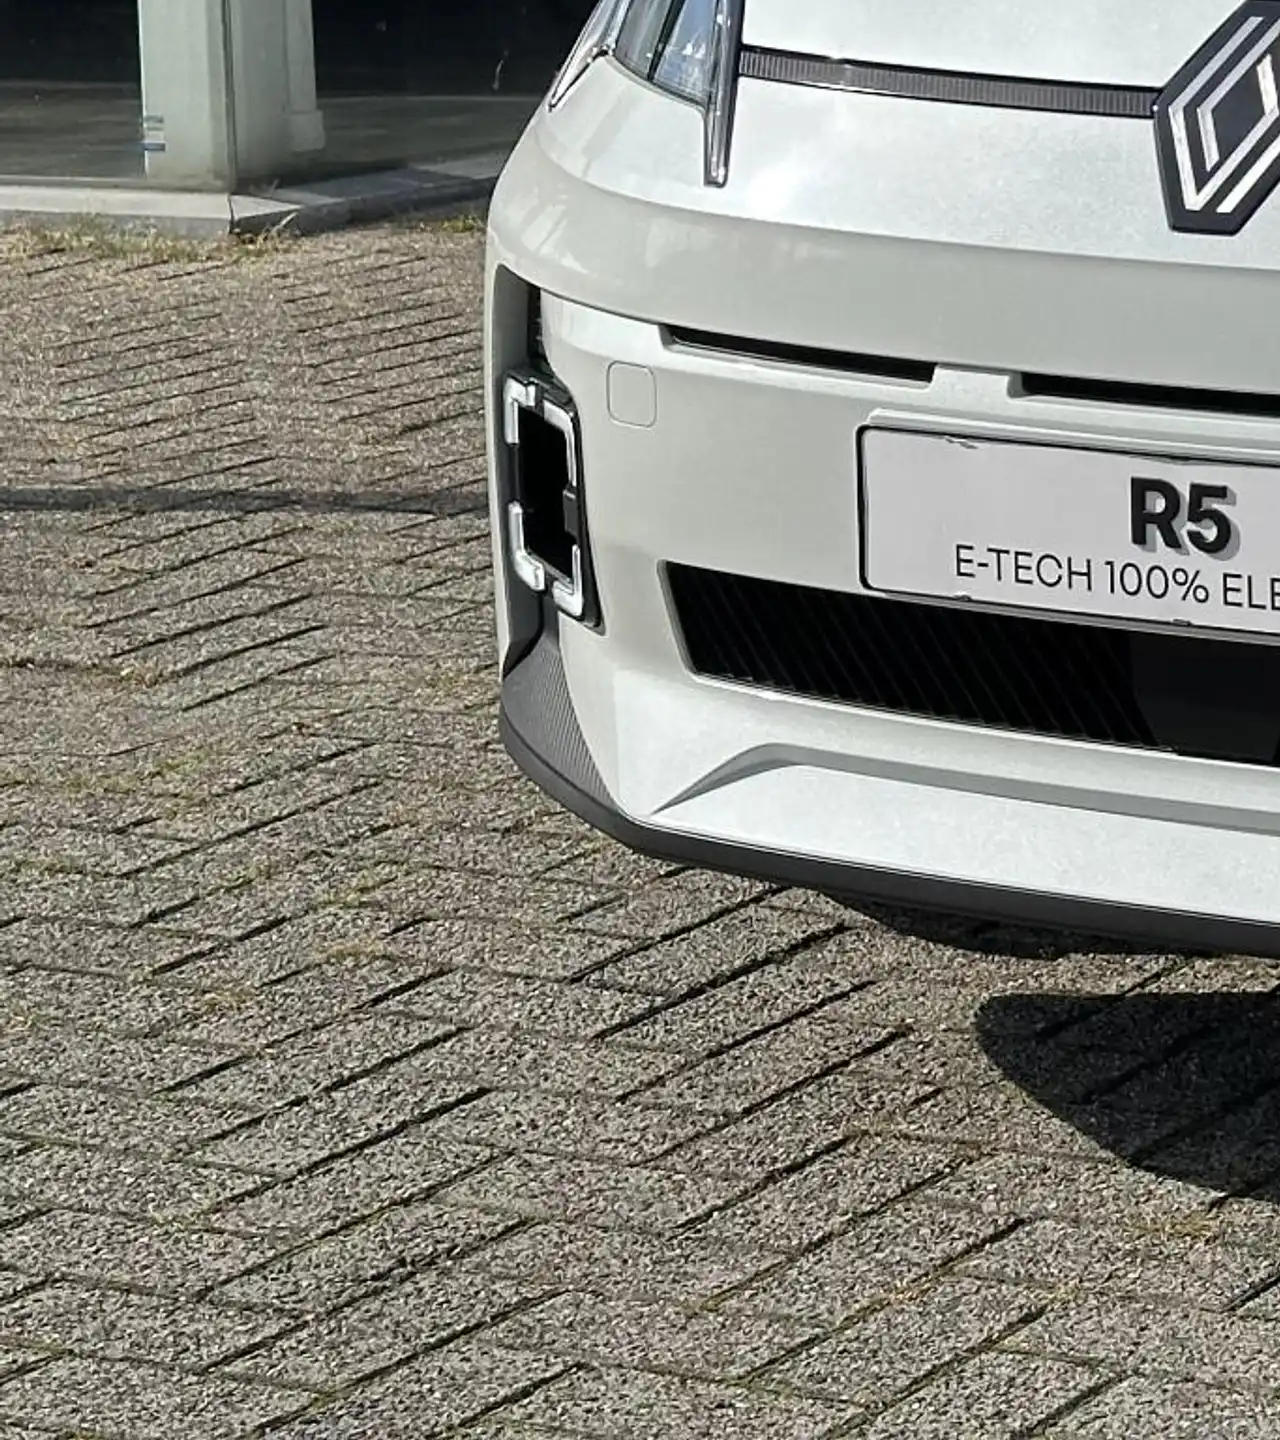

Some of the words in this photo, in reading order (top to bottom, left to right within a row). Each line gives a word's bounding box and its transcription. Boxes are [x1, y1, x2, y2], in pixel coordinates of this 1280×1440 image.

[1128, 476, 1239, 559] R5
[954, 542, 1094, 593] E-TECH
[1103, 559, 1211, 606] 100%
